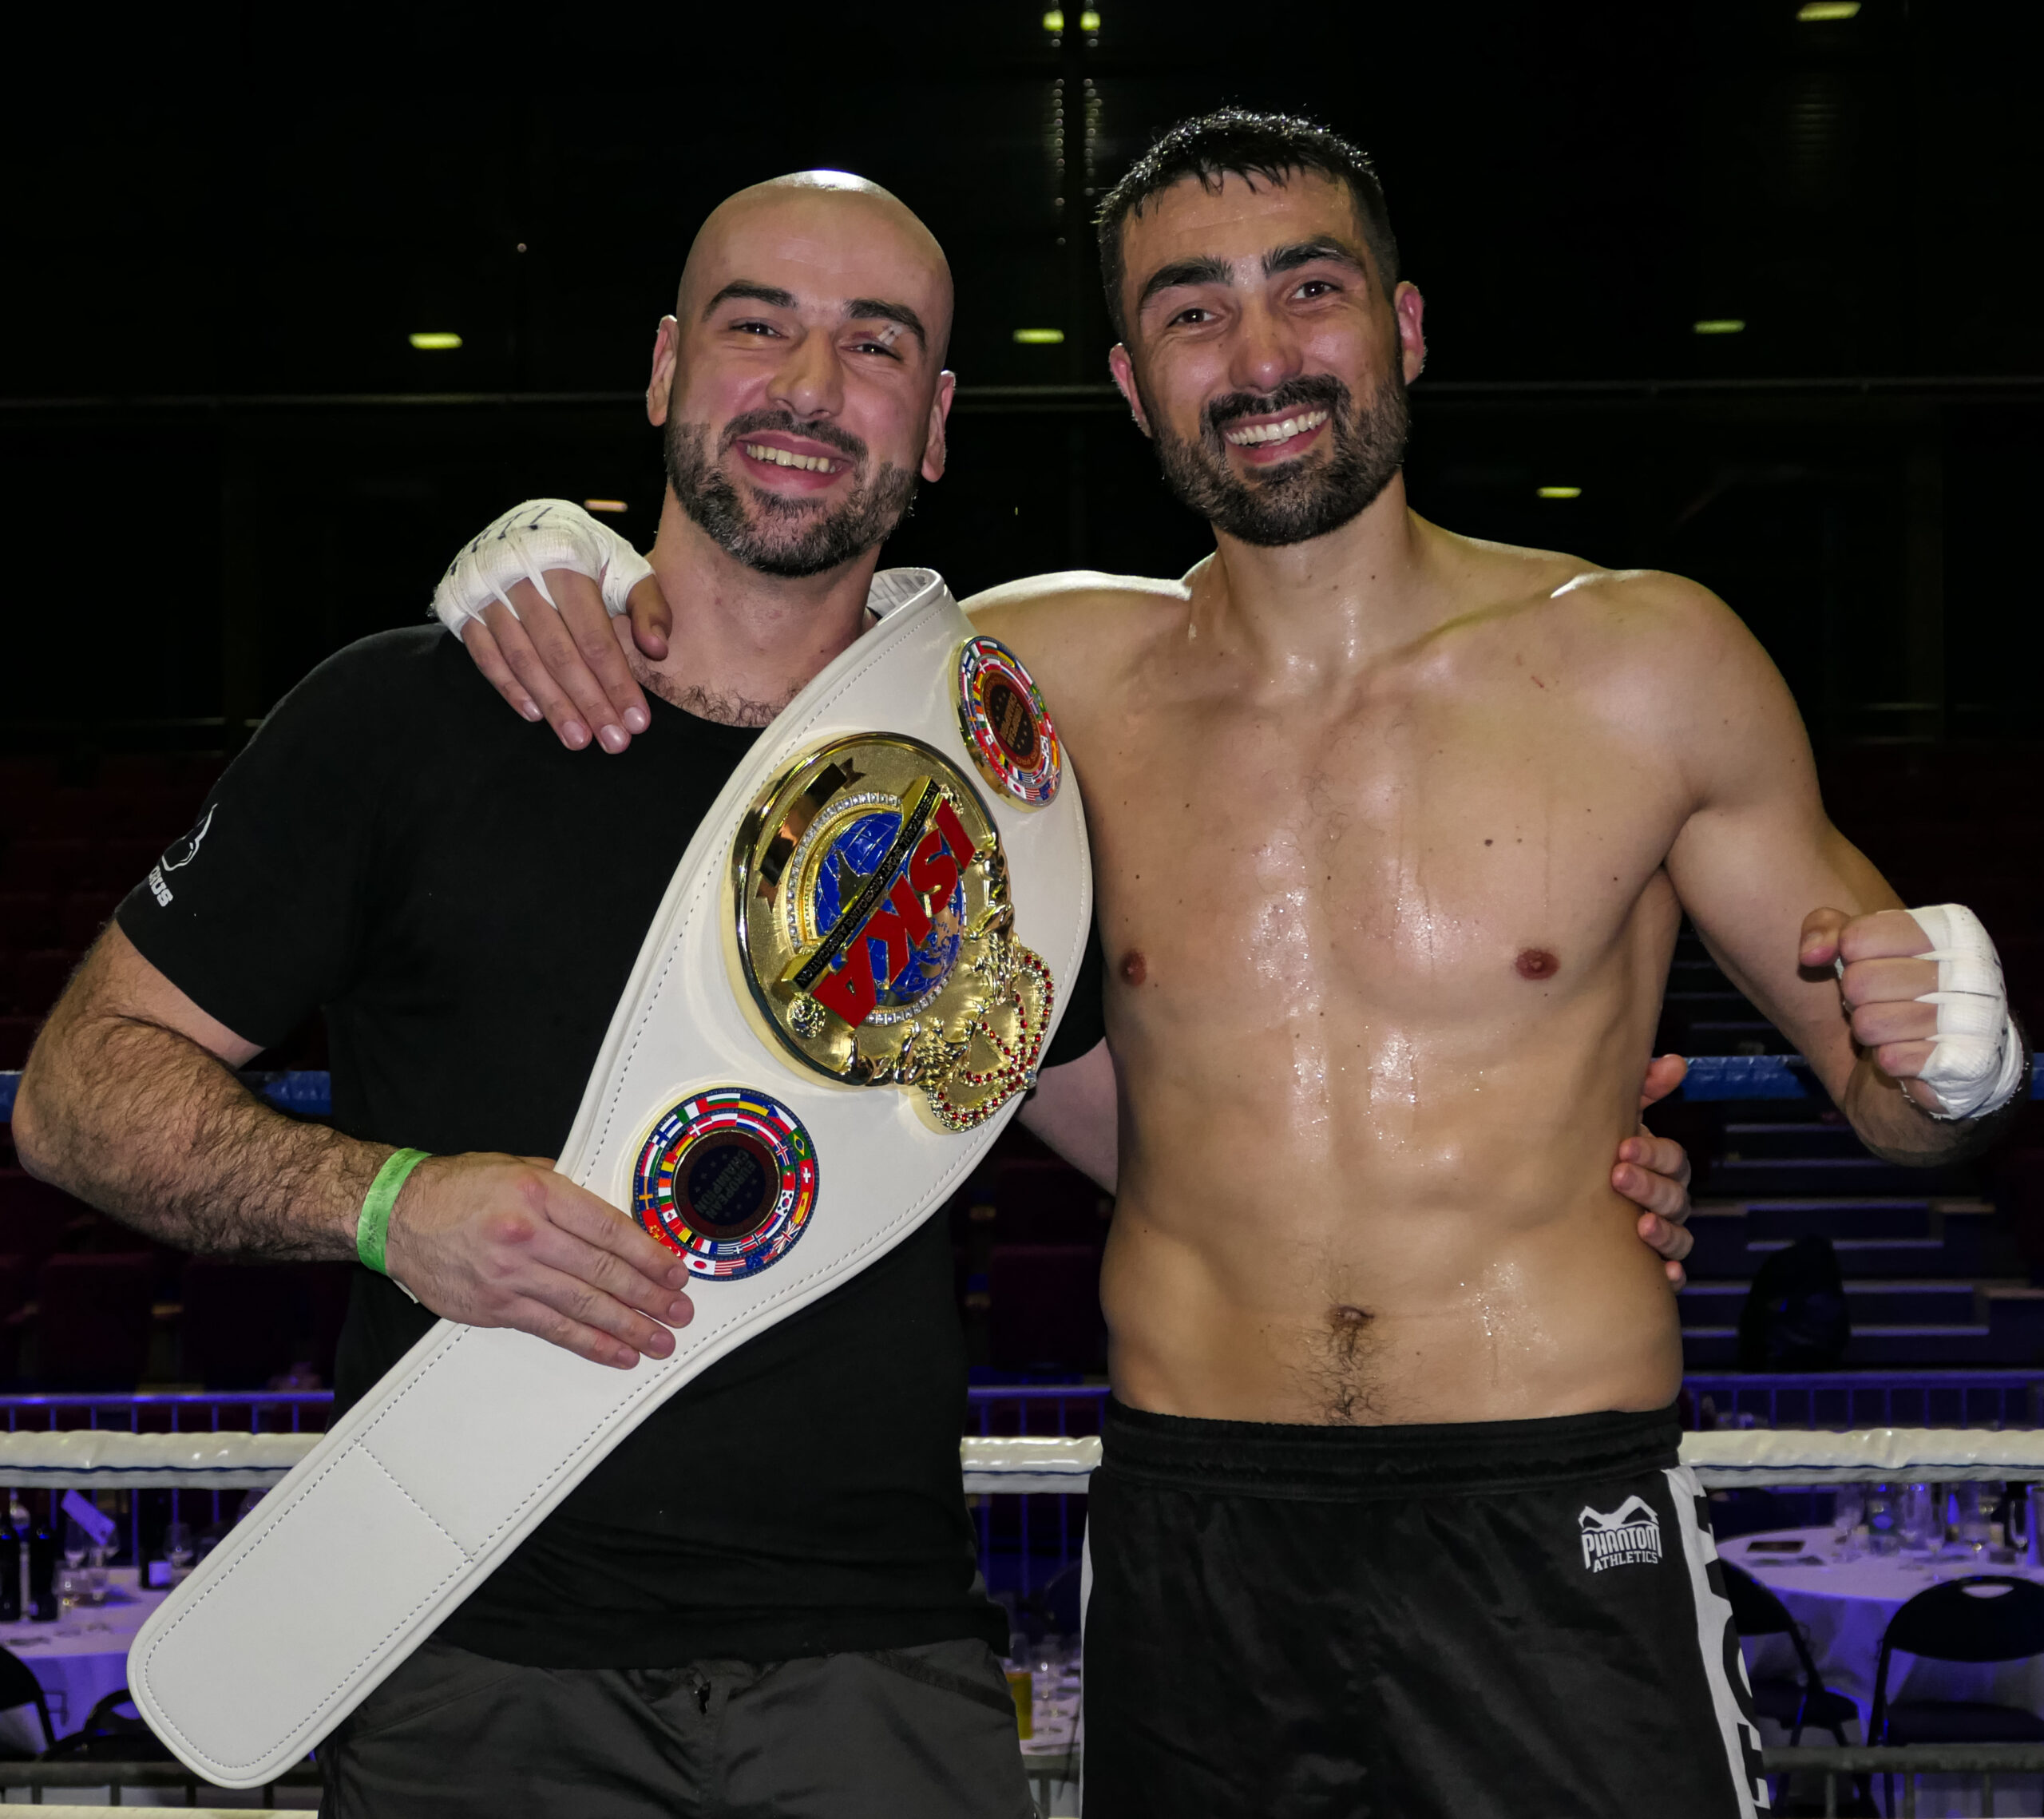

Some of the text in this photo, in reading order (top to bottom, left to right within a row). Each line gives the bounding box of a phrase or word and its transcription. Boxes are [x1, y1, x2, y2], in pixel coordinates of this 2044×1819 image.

[881, 845, 904, 878] SPORT
[813, 799, 976, 1029] ISKA
[845, 873, 885, 928] KICKBOXING
[797, 925, 847, 985] ASSOCIATION
[693, 1148, 751, 1214] CHAMPION
[704, 1160, 757, 1219] EUROPEAN
[1581, 1525, 1662, 1570] PHANTOM
[1593, 1550, 1658, 1573] ATHLETICS
